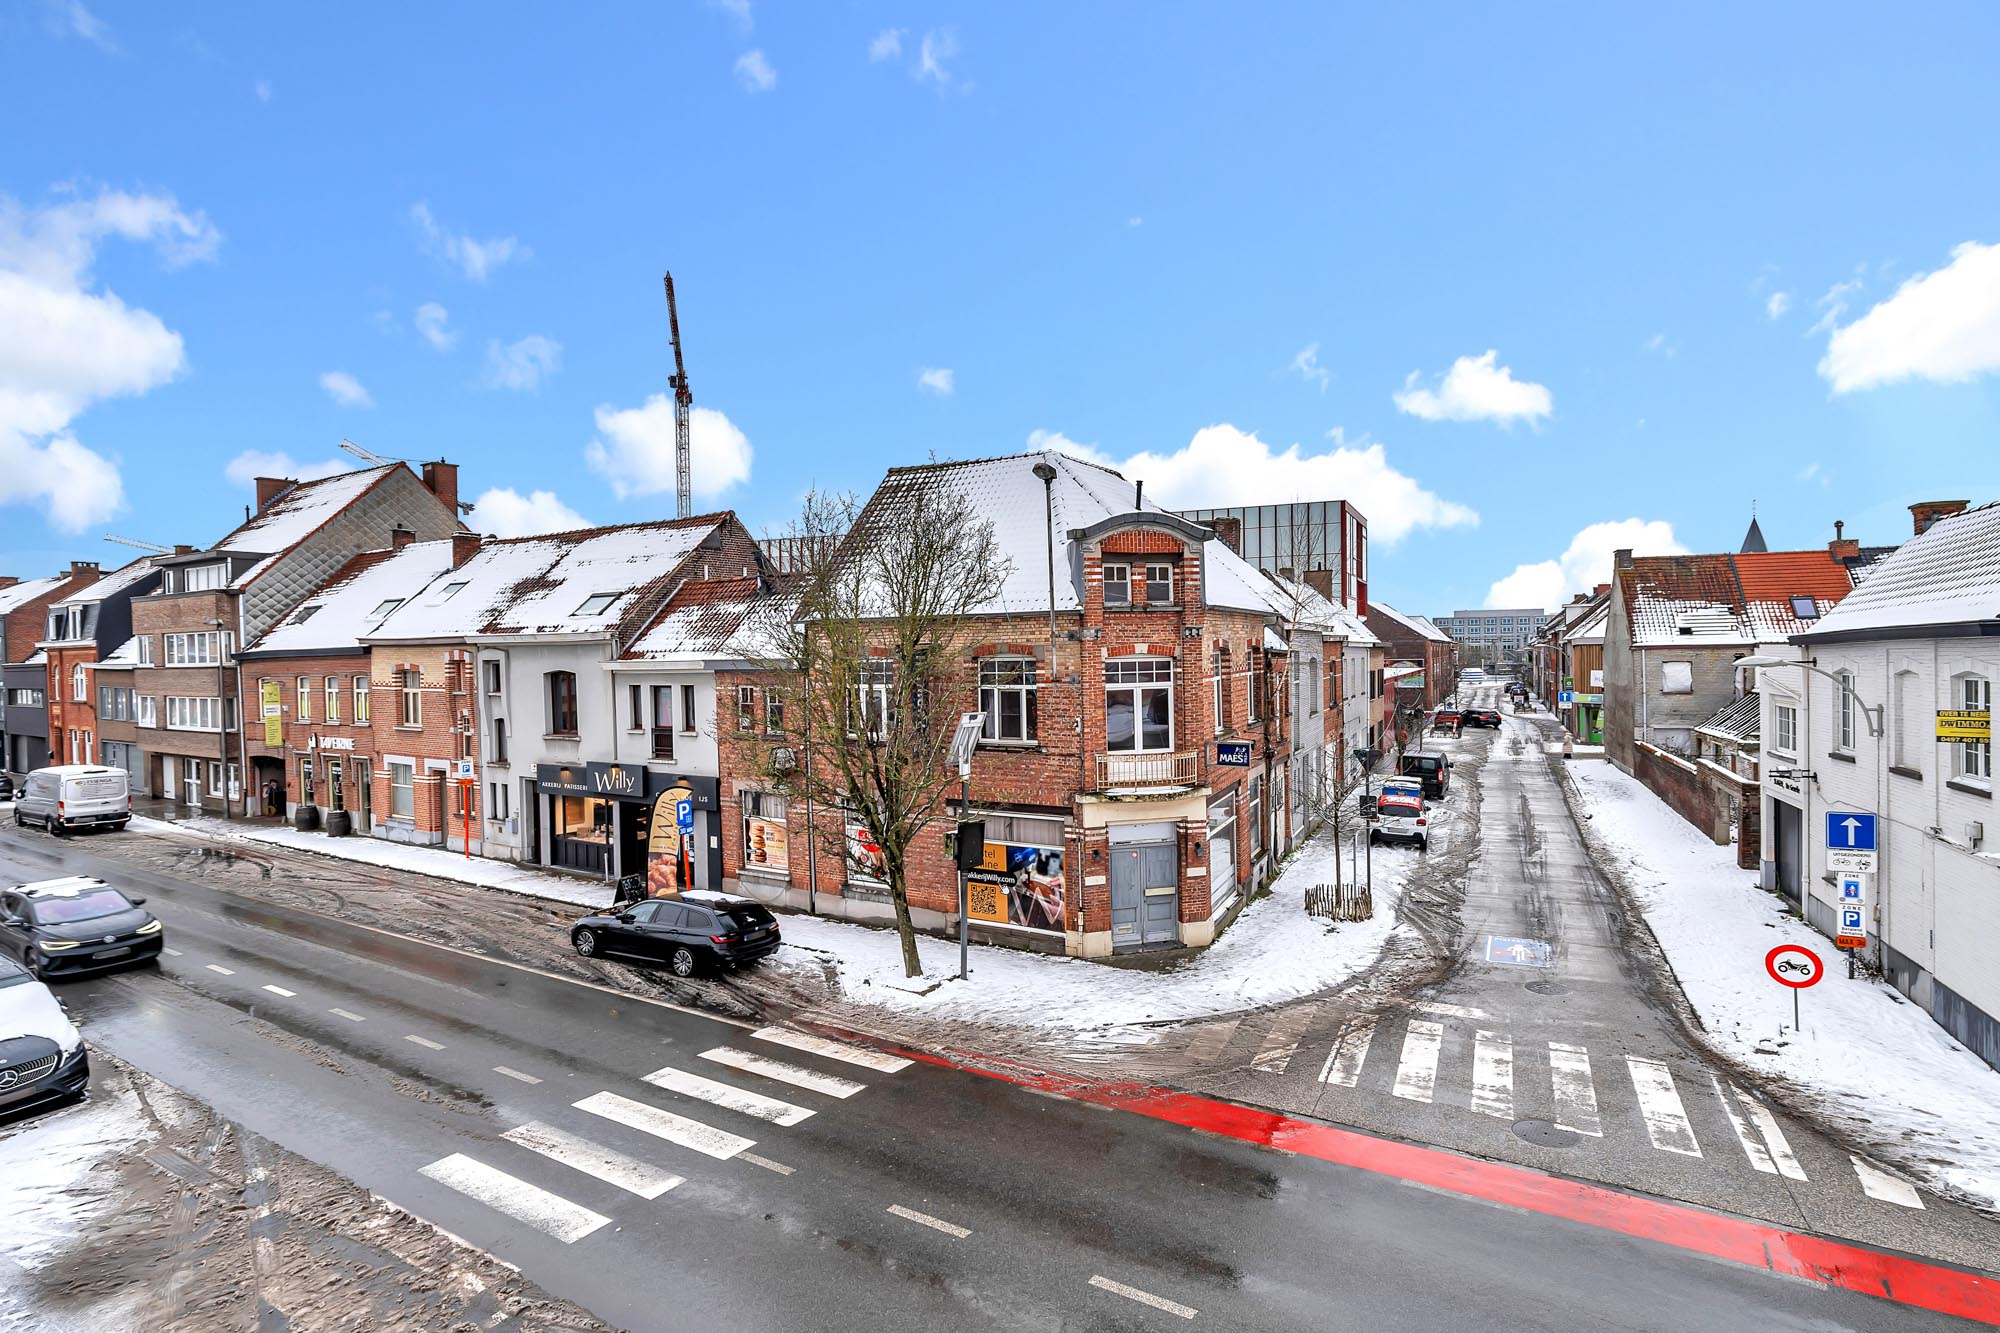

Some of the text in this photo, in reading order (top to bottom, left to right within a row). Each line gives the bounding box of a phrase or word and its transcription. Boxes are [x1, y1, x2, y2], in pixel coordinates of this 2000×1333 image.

[1219, 753, 1244, 763] MAES
[594, 770, 635, 793] Willy
[678, 802, 690, 821] P
[984, 849, 996, 859] tel
[967, 871, 1016, 884] akkerijWilly.com
[1845, 912, 1858, 926] P
